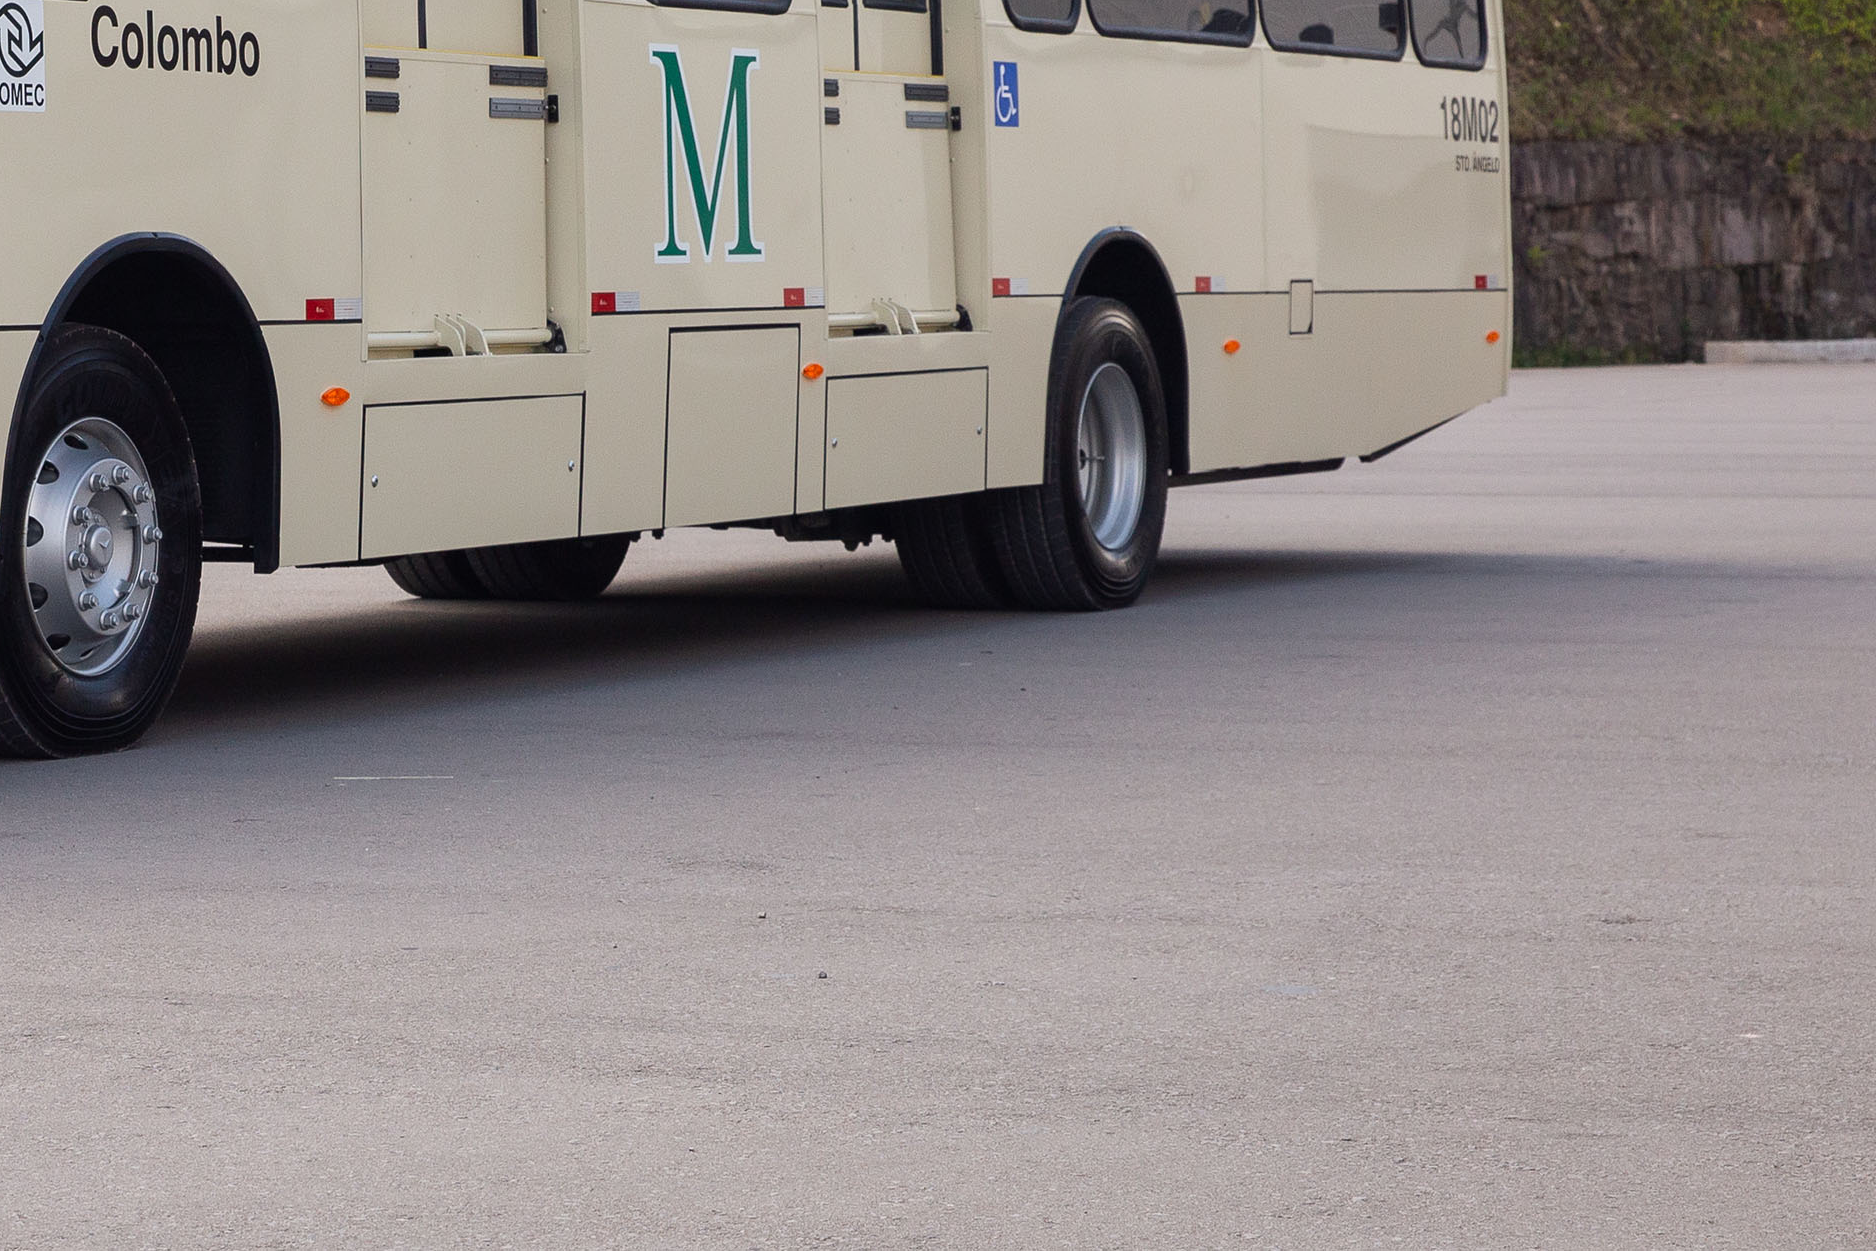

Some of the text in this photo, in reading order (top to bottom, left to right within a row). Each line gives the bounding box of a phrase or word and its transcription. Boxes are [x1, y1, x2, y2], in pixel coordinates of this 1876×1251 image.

[91, 5, 261, 77] Colombo
[650, 46, 764, 261] M
[1440, 96, 1499, 143] 18M02
